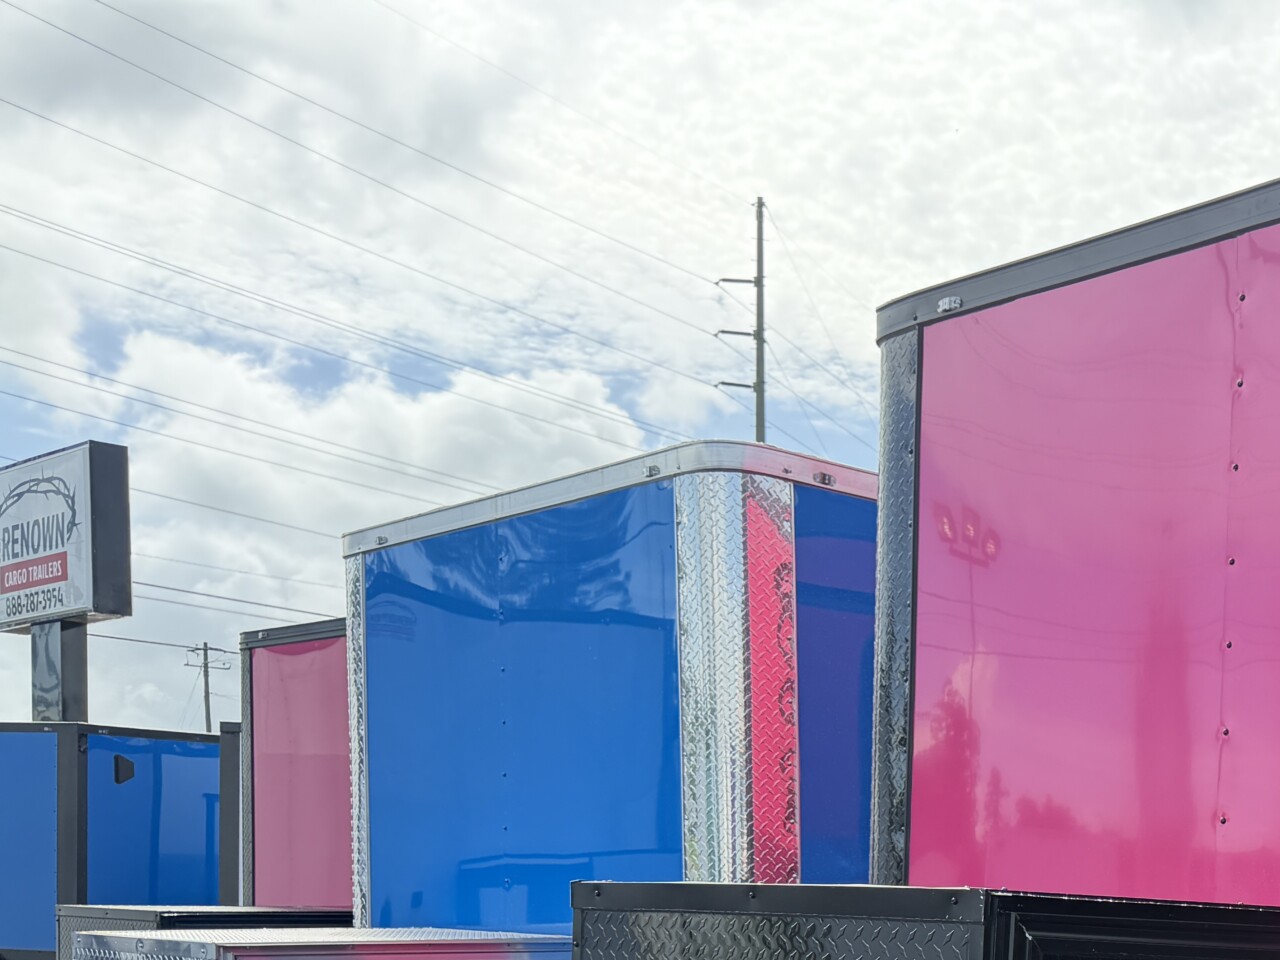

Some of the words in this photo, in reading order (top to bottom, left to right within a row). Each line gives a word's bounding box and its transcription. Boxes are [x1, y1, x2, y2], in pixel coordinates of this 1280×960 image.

[3, 512, 65, 561] RENOWN
[6, 568, 27, 587] CARGO
[29, 561, 62, 582] TRAILERS
[6, 587, 63, 617] 888-287-3954
